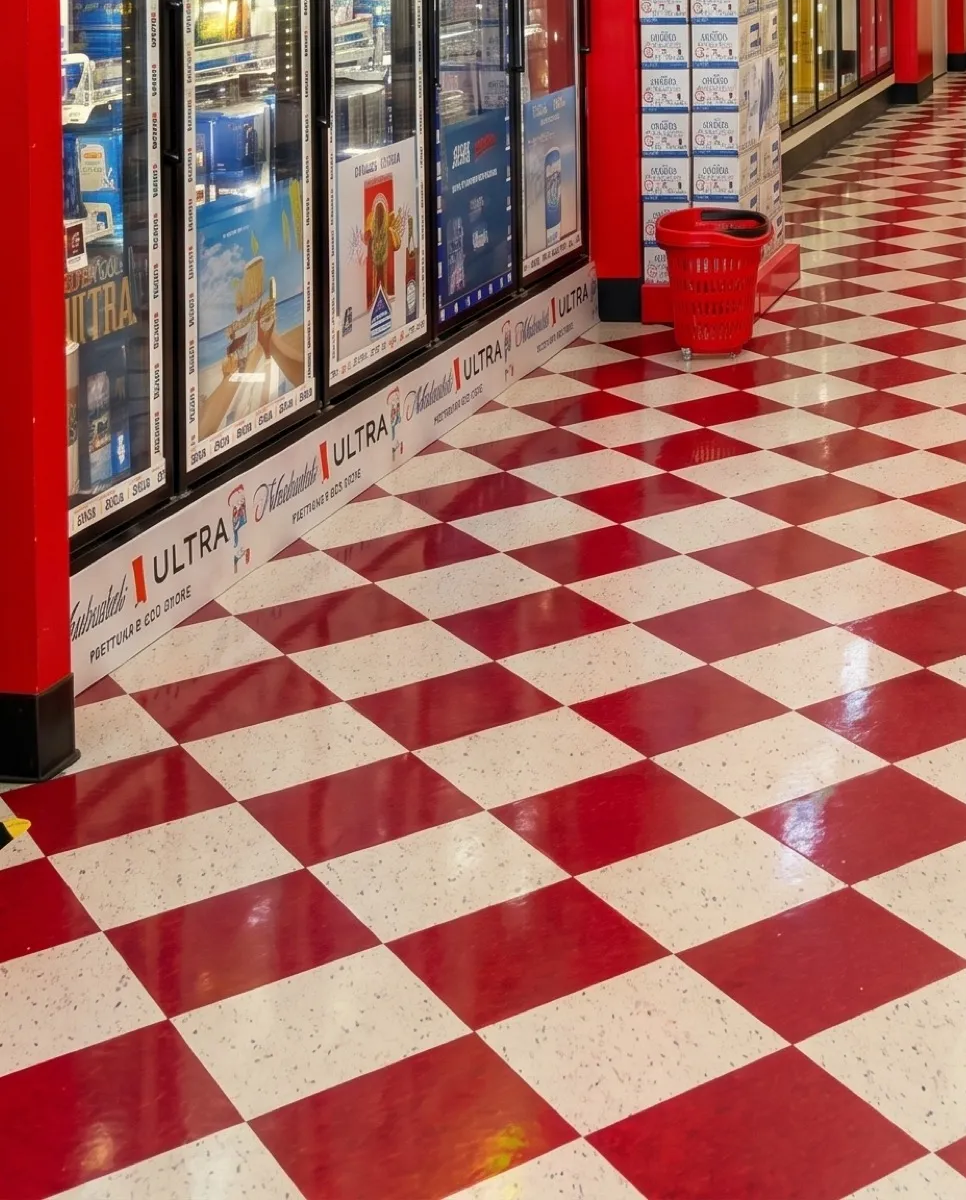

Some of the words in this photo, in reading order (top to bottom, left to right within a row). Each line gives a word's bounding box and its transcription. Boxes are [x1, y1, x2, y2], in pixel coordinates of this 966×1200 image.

[558, 283, 589, 318] ULTRA
[463, 340, 503, 381] ULTRA
[333, 414, 388, 467] ULTRA
[153, 517, 229, 584] ULTRA
